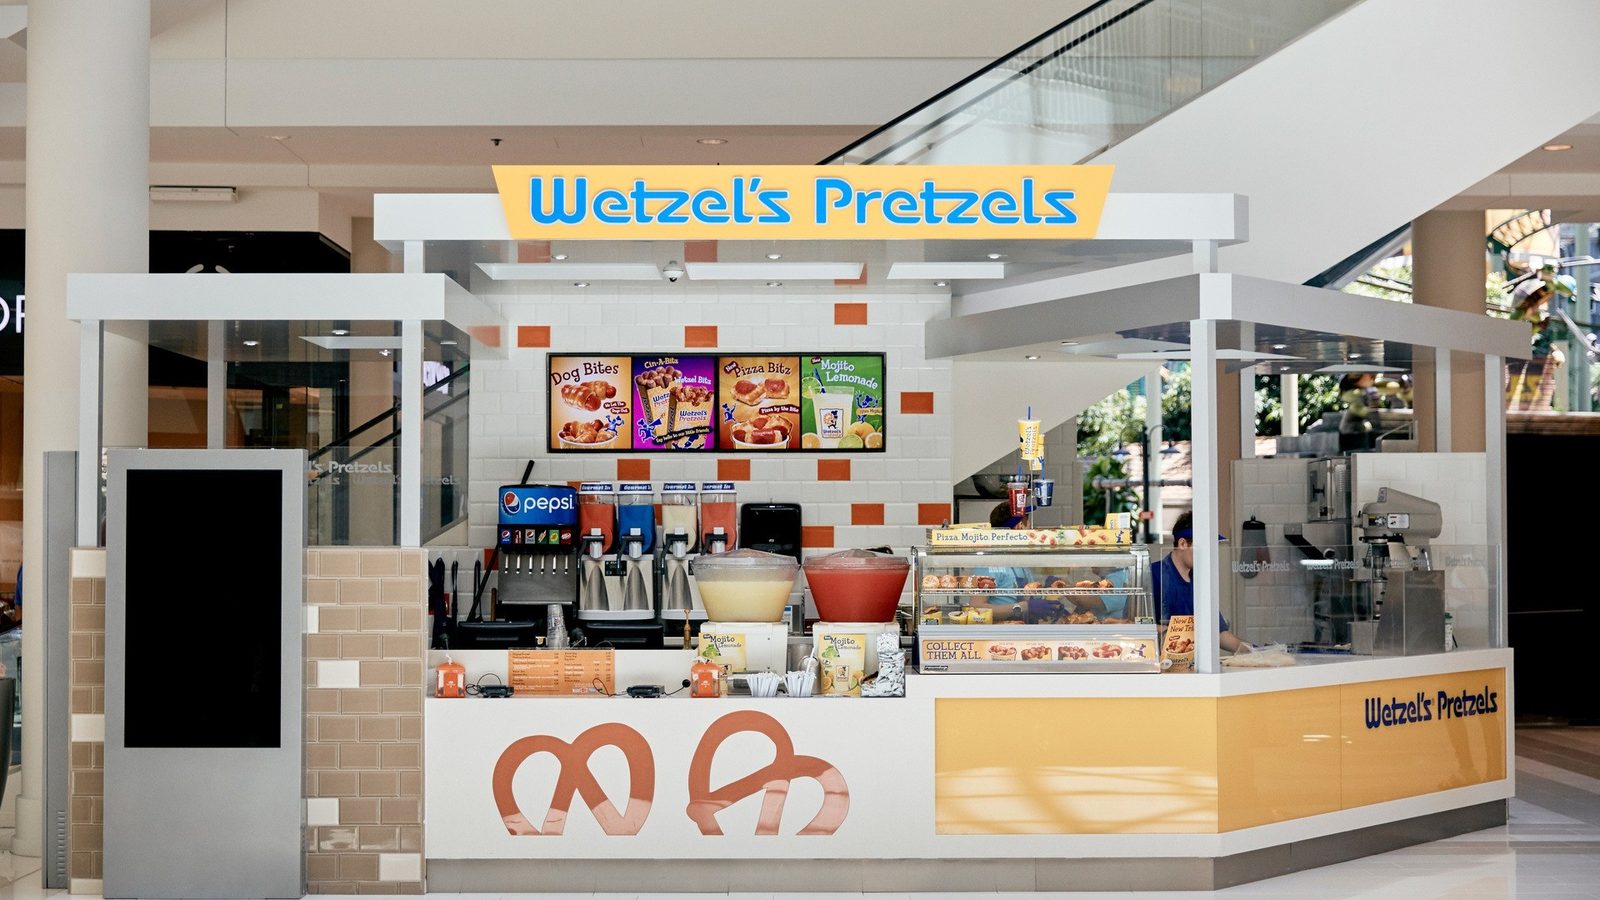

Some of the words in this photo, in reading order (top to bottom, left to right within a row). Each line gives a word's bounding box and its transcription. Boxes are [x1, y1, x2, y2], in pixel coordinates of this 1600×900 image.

[530, 176, 791, 225] Wetzel's
[815, 177, 1078, 225] Pretzels
[551, 368, 581, 385] Dog
[583, 361, 619, 375] Bites
[734, 365, 764, 378] Pizza
[768, 362, 791, 375] Bitz
[821, 360, 855, 373] Mojito
[826, 371, 878, 389] Lemonade
[329, 460, 393, 473] Pretzels
[524, 494, 573, 513] pepsi
[1232, 560, 1260, 573] Wetzel's
[1261, 560, 1290, 572] Pretzels
[710, 635, 735, 644] Mojito
[830, 637, 856, 646] Mojito
[926, 642, 974, 650] COLLECT
[927, 651, 957, 660] THEM
[1365, 692, 1432, 729] Wetzel's
[1438, 685, 1498, 720] Pretzels
